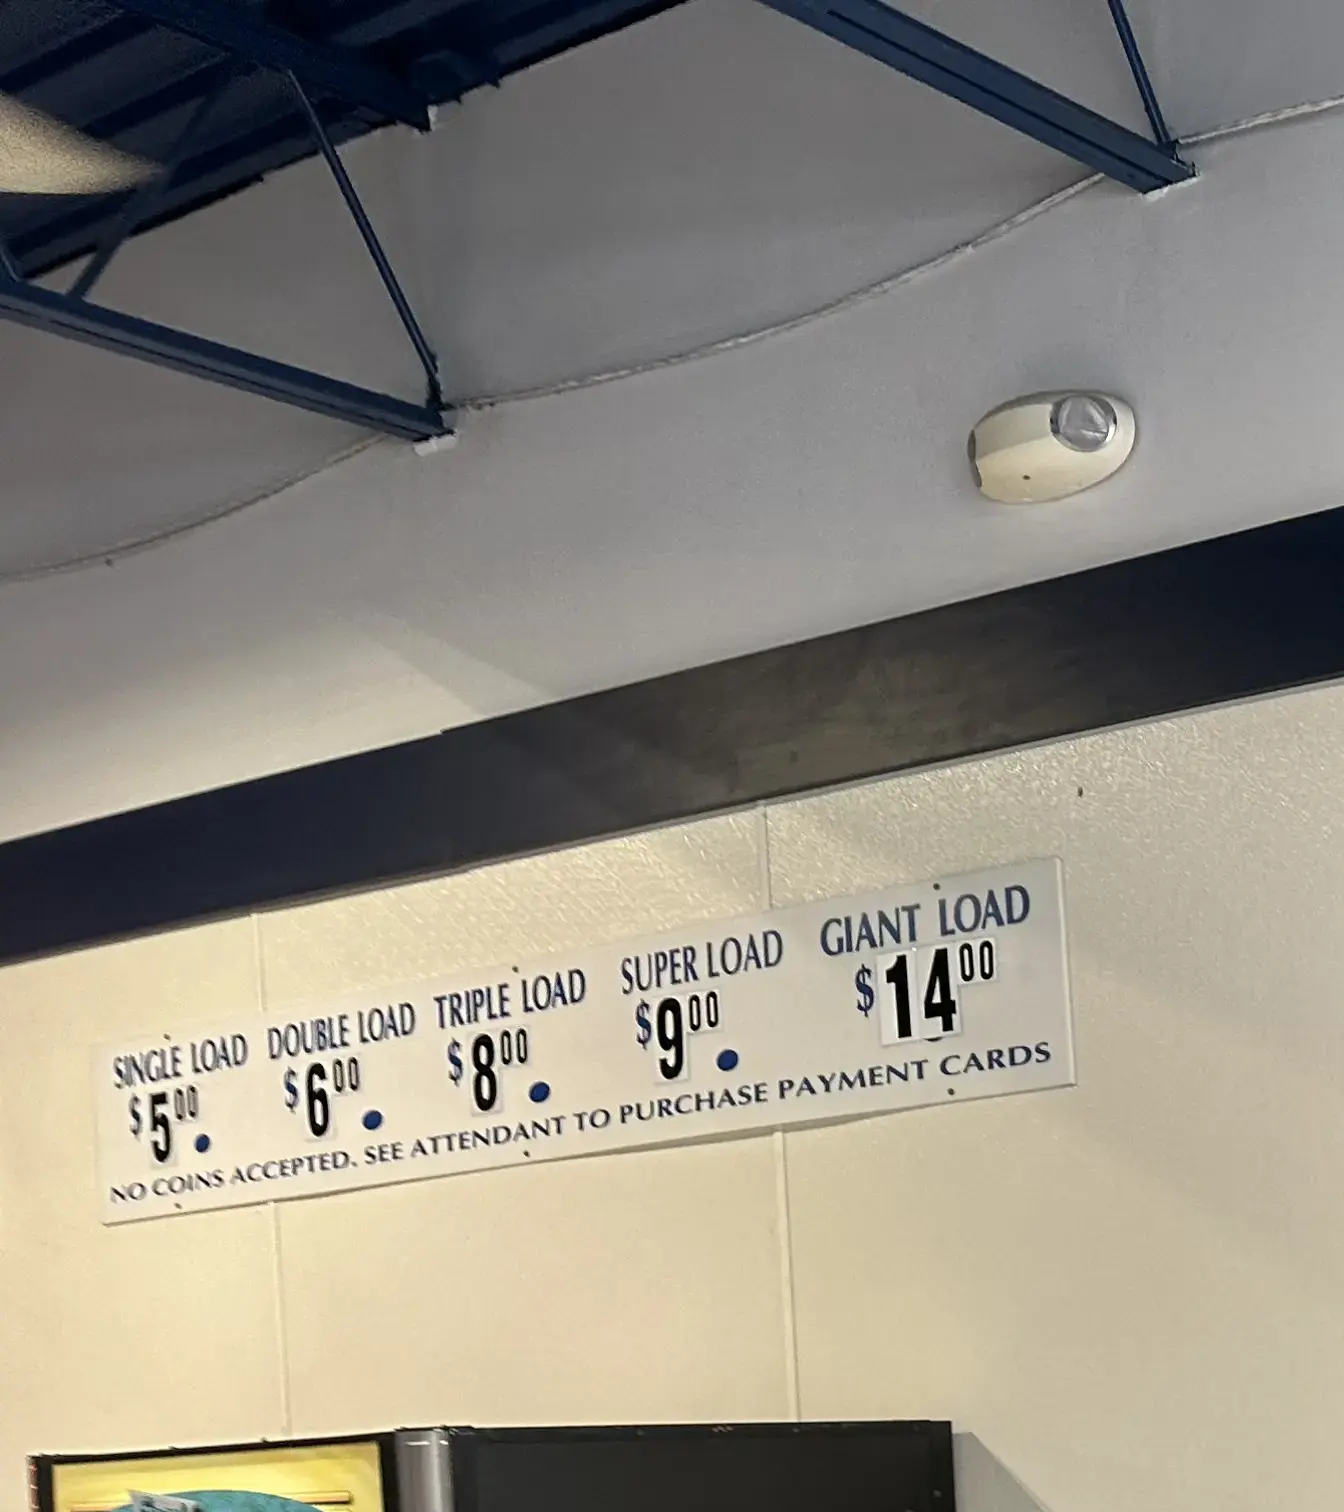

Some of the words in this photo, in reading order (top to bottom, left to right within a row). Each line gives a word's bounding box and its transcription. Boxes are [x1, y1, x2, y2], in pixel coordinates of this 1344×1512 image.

[819, 902, 921, 957] GIANT
[938, 884, 1031, 937] LOAD
[620, 946, 699, 995] SUPER
[707, 929, 783, 979] LOAD
[267, 1014, 351, 1060] DOUBLE
[358, 1001, 416, 1044] LOAD
[433, 982, 511, 1030] TRIPLE
[521, 968, 586, 1013] LOAD
[112, 1040, 182, 1091] SINGLE
[190, 1032, 249, 1072] LOAD
[109, 1182, 146, 1204] NO
[152, 1168, 226, 1198] COINS
[230, 1149, 358, 1187] ACCEPTED.
[363, 1141, 405, 1165] SEE
[411, 1114, 568, 1158] ATTENDANT
[575, 1108, 611, 1132] TO
[619, 1082, 769, 1125] PURCHASE
[778, 1058, 929, 1100] PAYMENT
[939, 1041, 1052, 1077] CARDS
